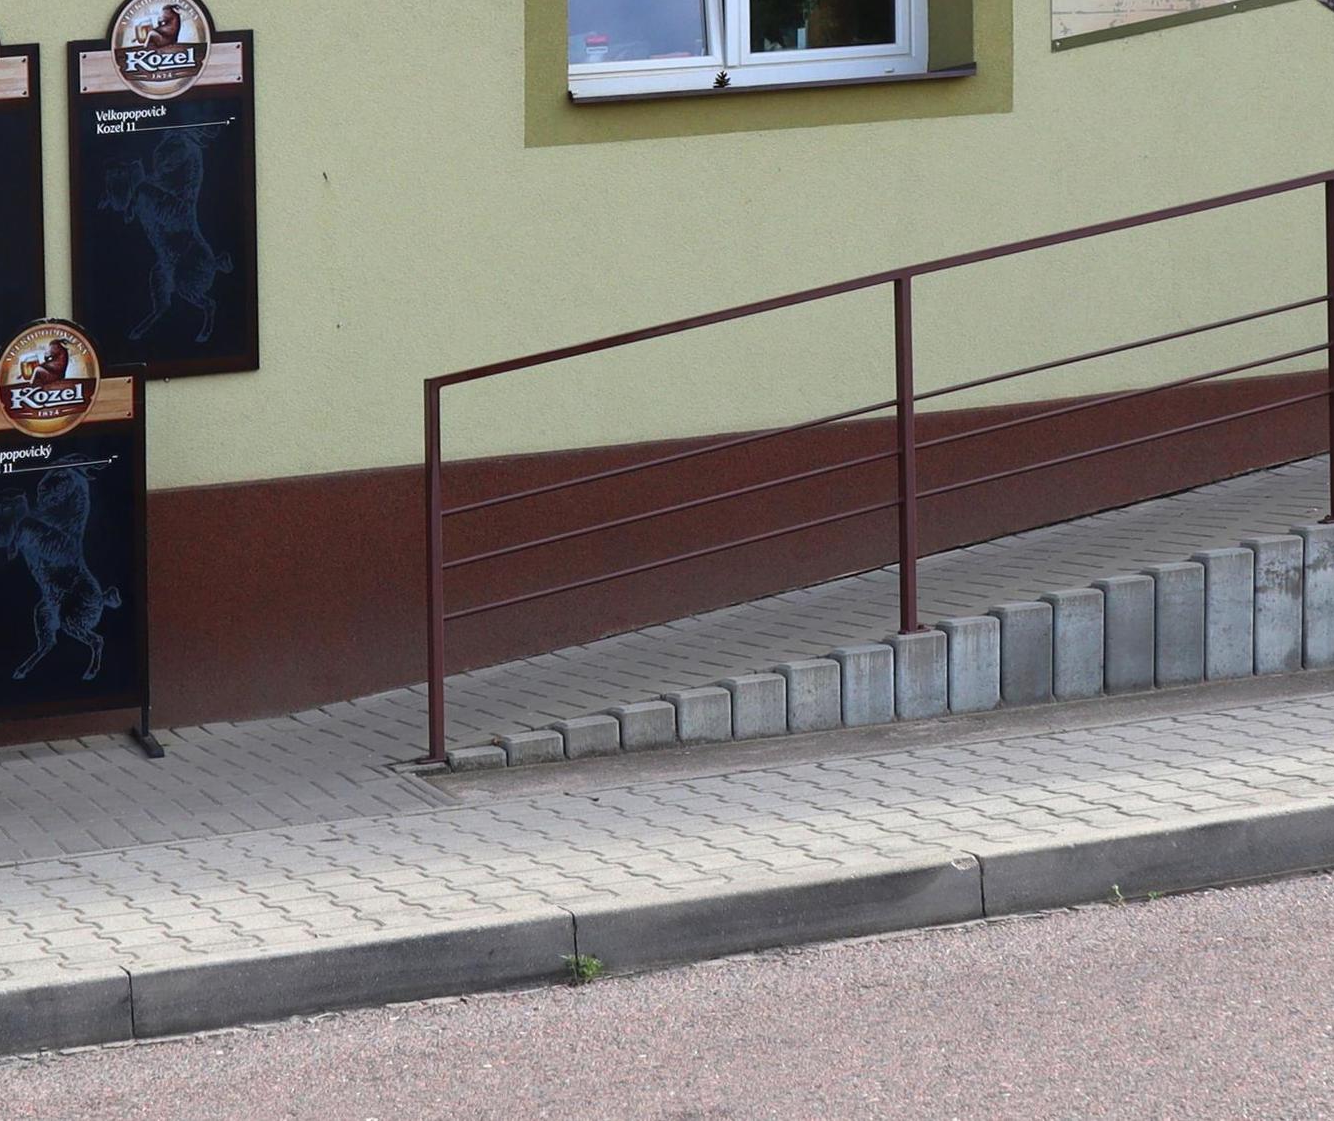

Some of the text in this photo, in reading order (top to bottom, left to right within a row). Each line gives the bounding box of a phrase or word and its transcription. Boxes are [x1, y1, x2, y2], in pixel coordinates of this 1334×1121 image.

[125, 47, 195, 72] Kozel
[96, 122, 124, 135] Kozel
[126, 121, 136, 133] 11
[10, 383, 84, 410] Kozel
[3, 463, 13, 474] 11
